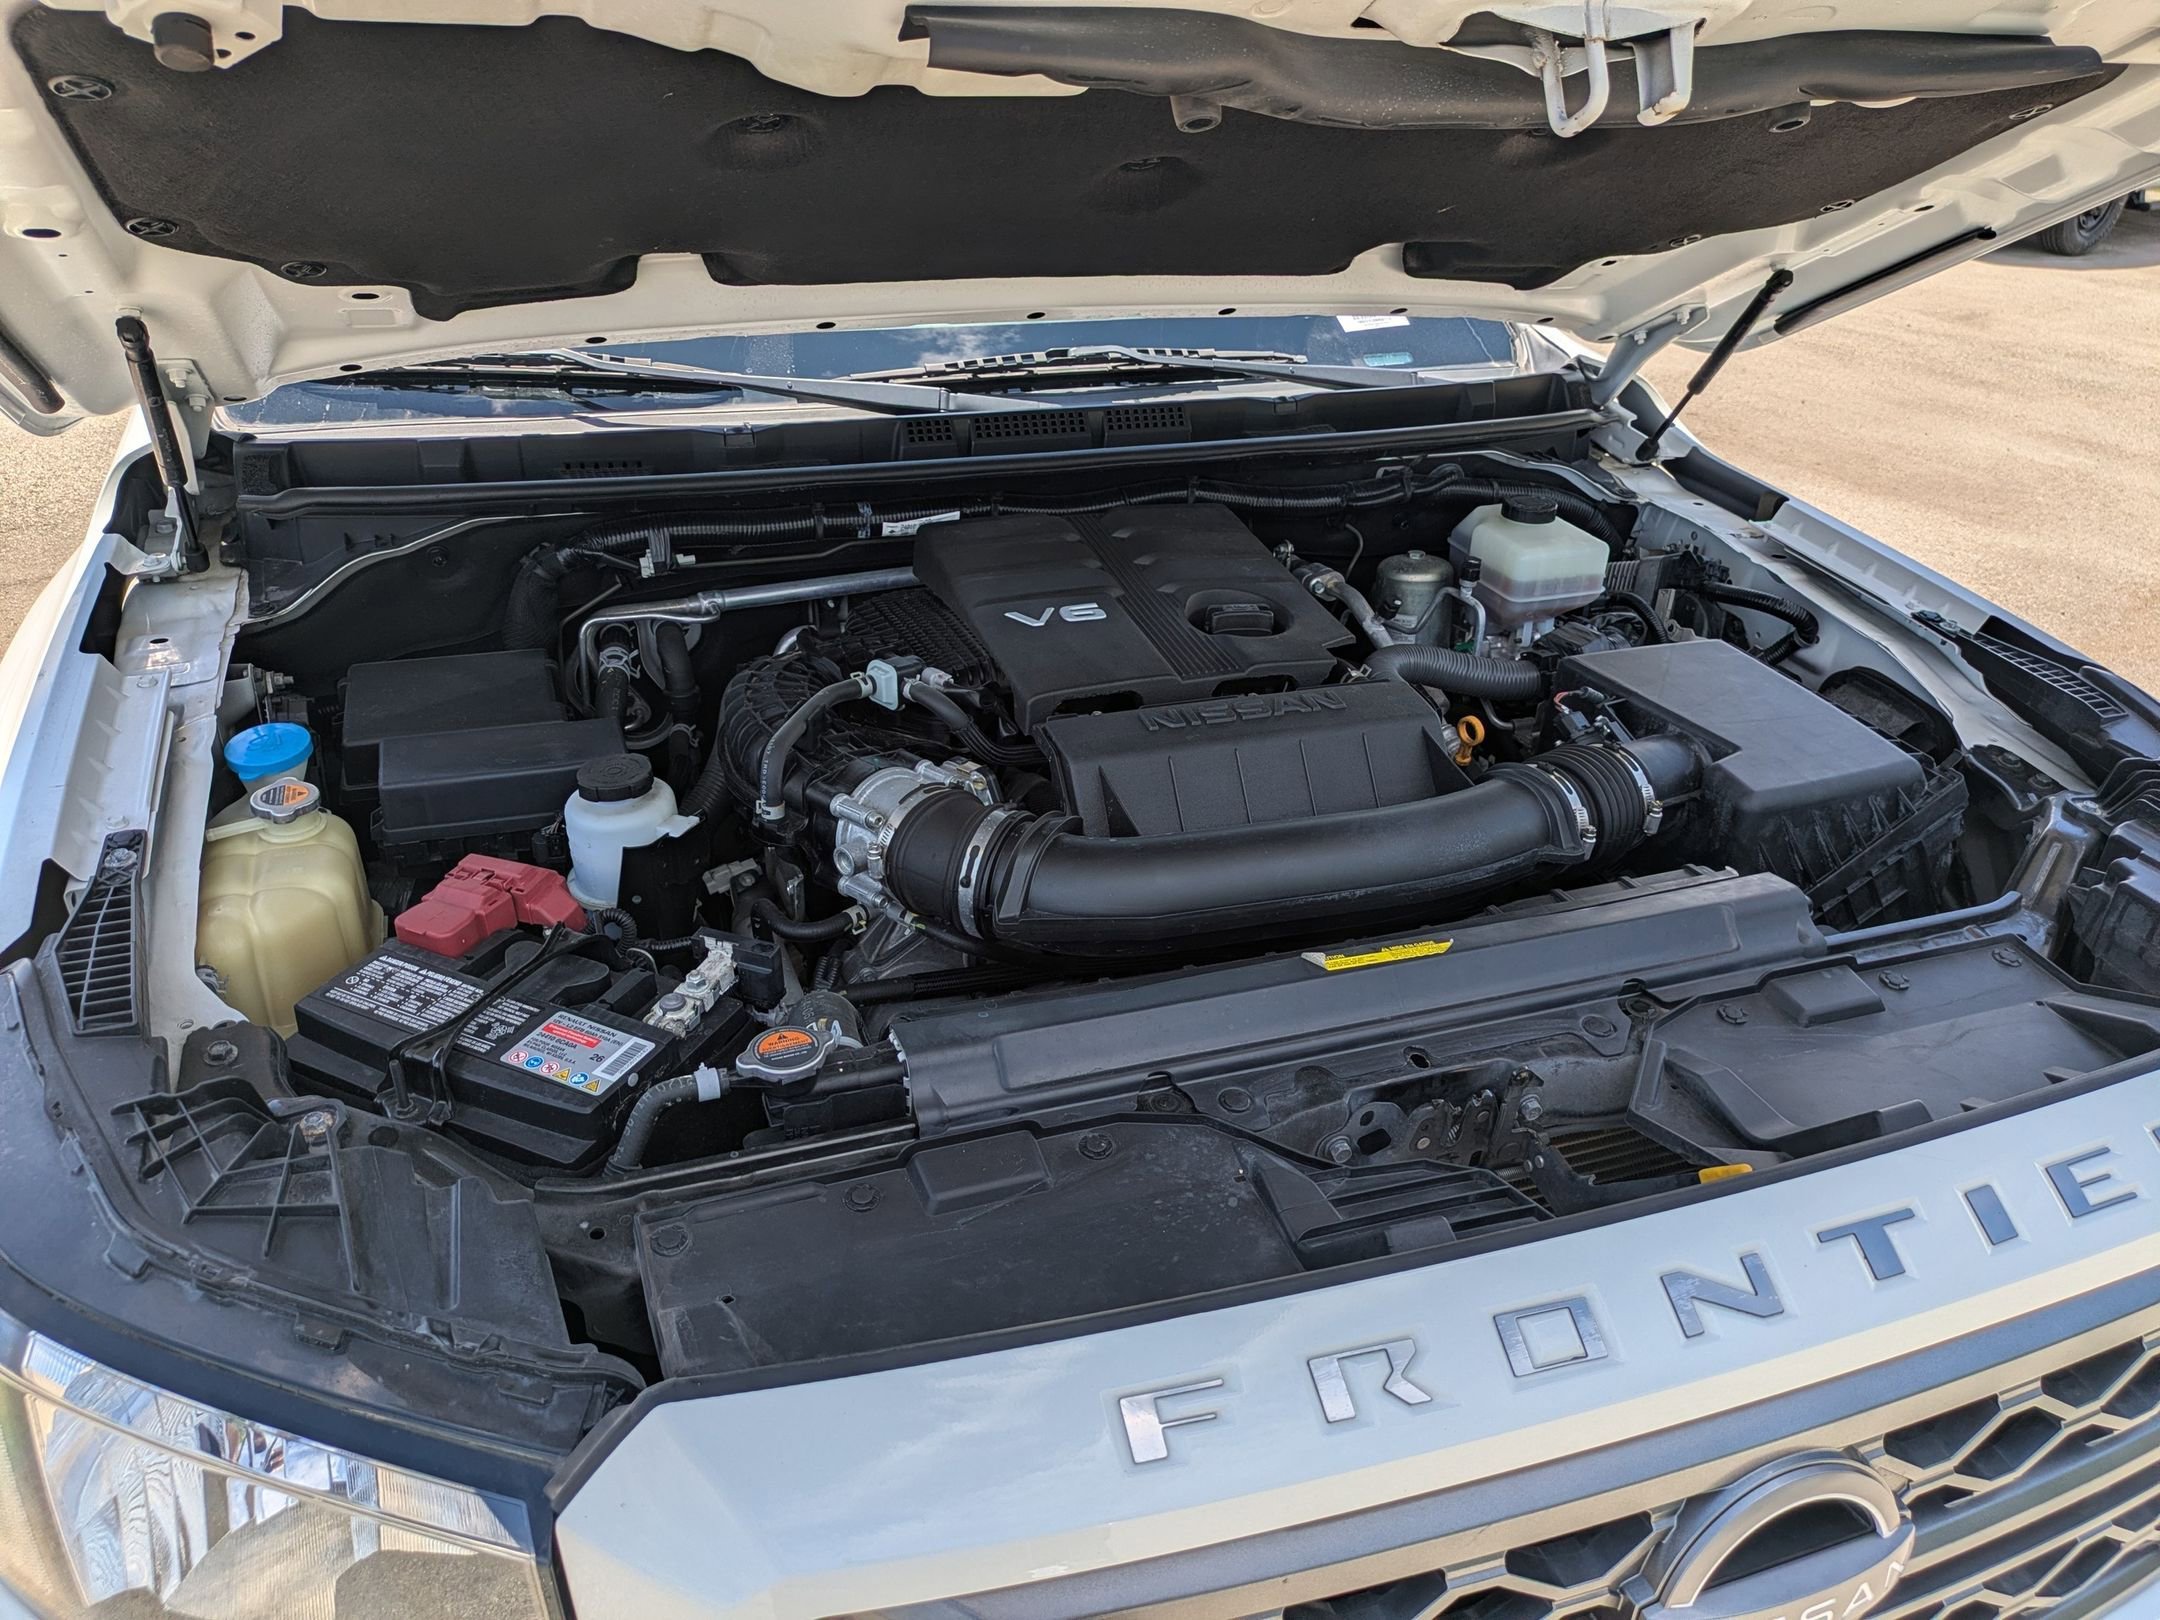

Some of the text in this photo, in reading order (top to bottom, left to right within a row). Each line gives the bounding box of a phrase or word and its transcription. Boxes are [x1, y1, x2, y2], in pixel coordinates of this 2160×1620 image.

[1004, 602, 1107, 627] V6
[1139, 690, 1347, 731] NISSAN
[557, 1014, 617, 1038] RENAULT NISSAN
[768, 1036, 800, 1046] WARNING
[589, 1053, 605, 1063] 26
[1119, 1127, 2160, 1464] FRONTIE
[1772, 1561, 1904, 1620] SAN
